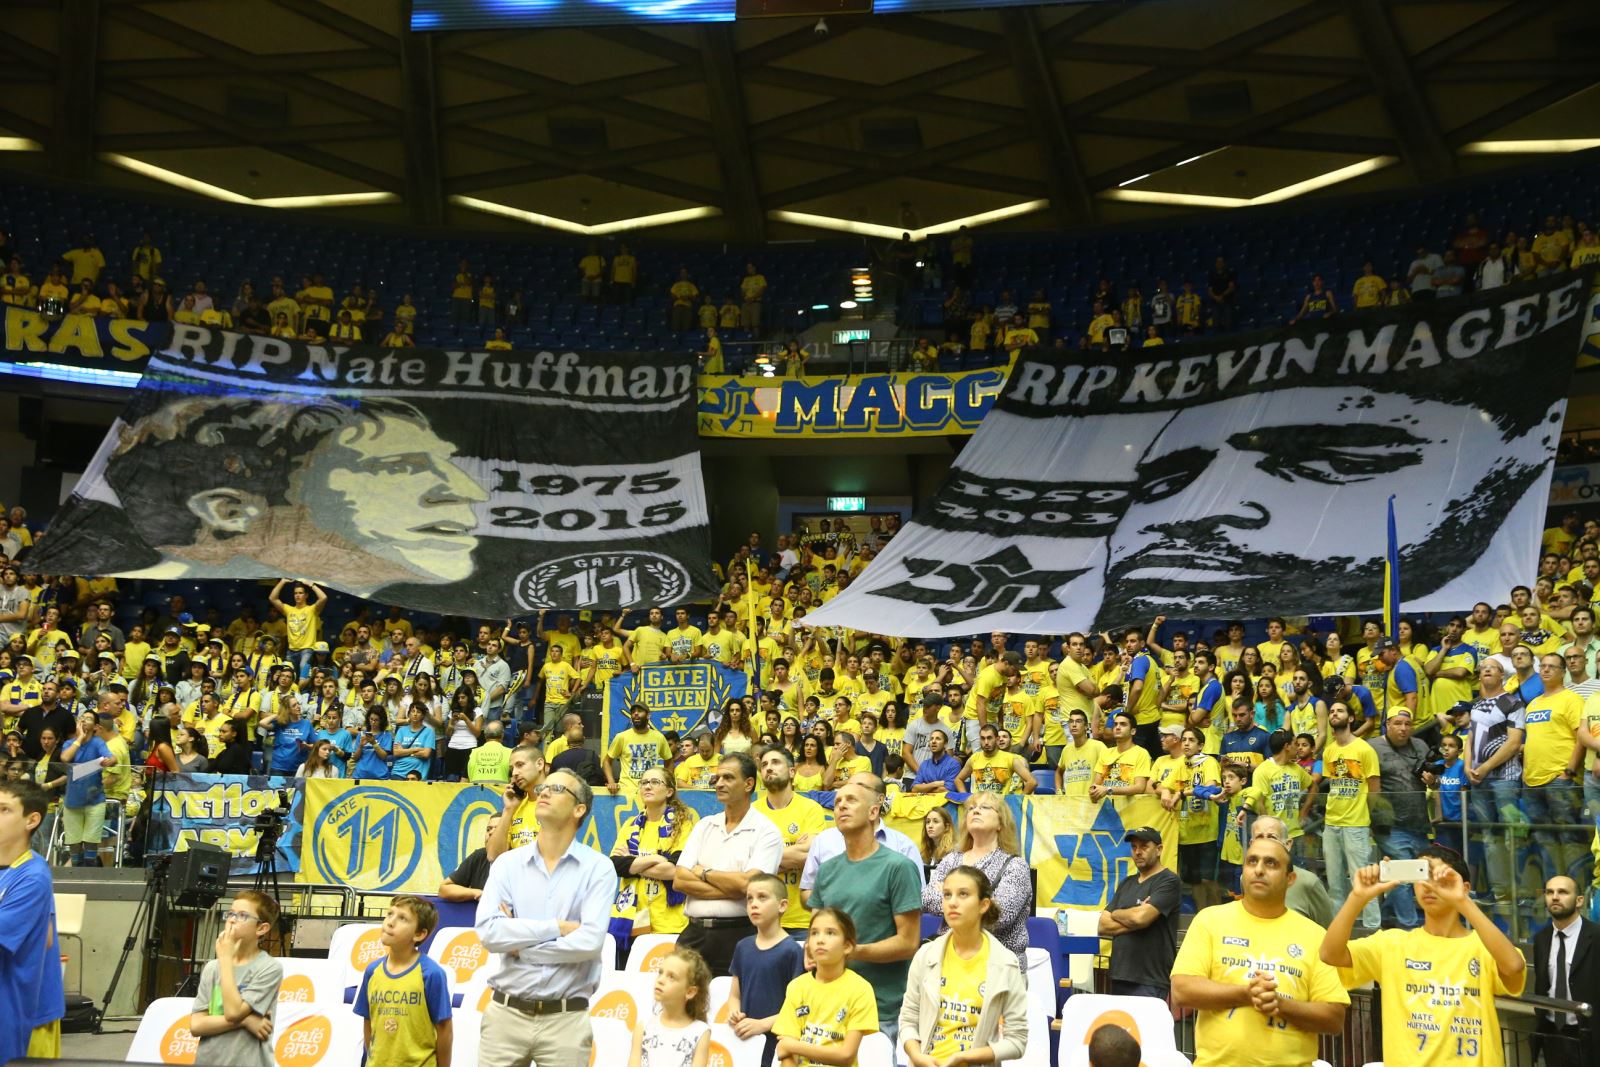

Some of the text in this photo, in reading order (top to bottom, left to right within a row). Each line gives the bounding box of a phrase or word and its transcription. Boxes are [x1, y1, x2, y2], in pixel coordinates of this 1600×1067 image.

[1007, 278, 1583, 406] RIP KEVIN MAGEE
[158, 320, 693, 400] RIP Nate Huffman
[491, 467, 682, 497] 1975
[949, 479, 1131, 505] 1959
[489, 499, 688, 532] 2015
[934, 500, 1119, 526] 2003
[573, 556, 635, 570] GATE
[557, 567, 643, 609] 11
[648, 669, 705, 687] GATE
[644, 689, 706, 708] ELEVEN
[1526, 711, 1549, 723] FOX
[327, 797, 358, 825] GATE
[173, 826, 287, 858] ARM
[337, 805, 401, 883] 11
[783, 871, 797, 885] 13
[451, 944, 484, 959] café
[1406, 960, 1431, 970] FOX
[370, 990, 423, 1006] MACCABI
[1411, 1012, 1433, 1021] NATE
[1453, 1015, 1482, 1026] KEVIN
[1406, 1021, 1440, 1032] HUFFMAN
[289, 1029, 325, 1044] café
[1416, 1033, 1427, 1052] 7
[283, 1042, 319, 1059] café
[1456, 1036, 1479, 1057] 13
